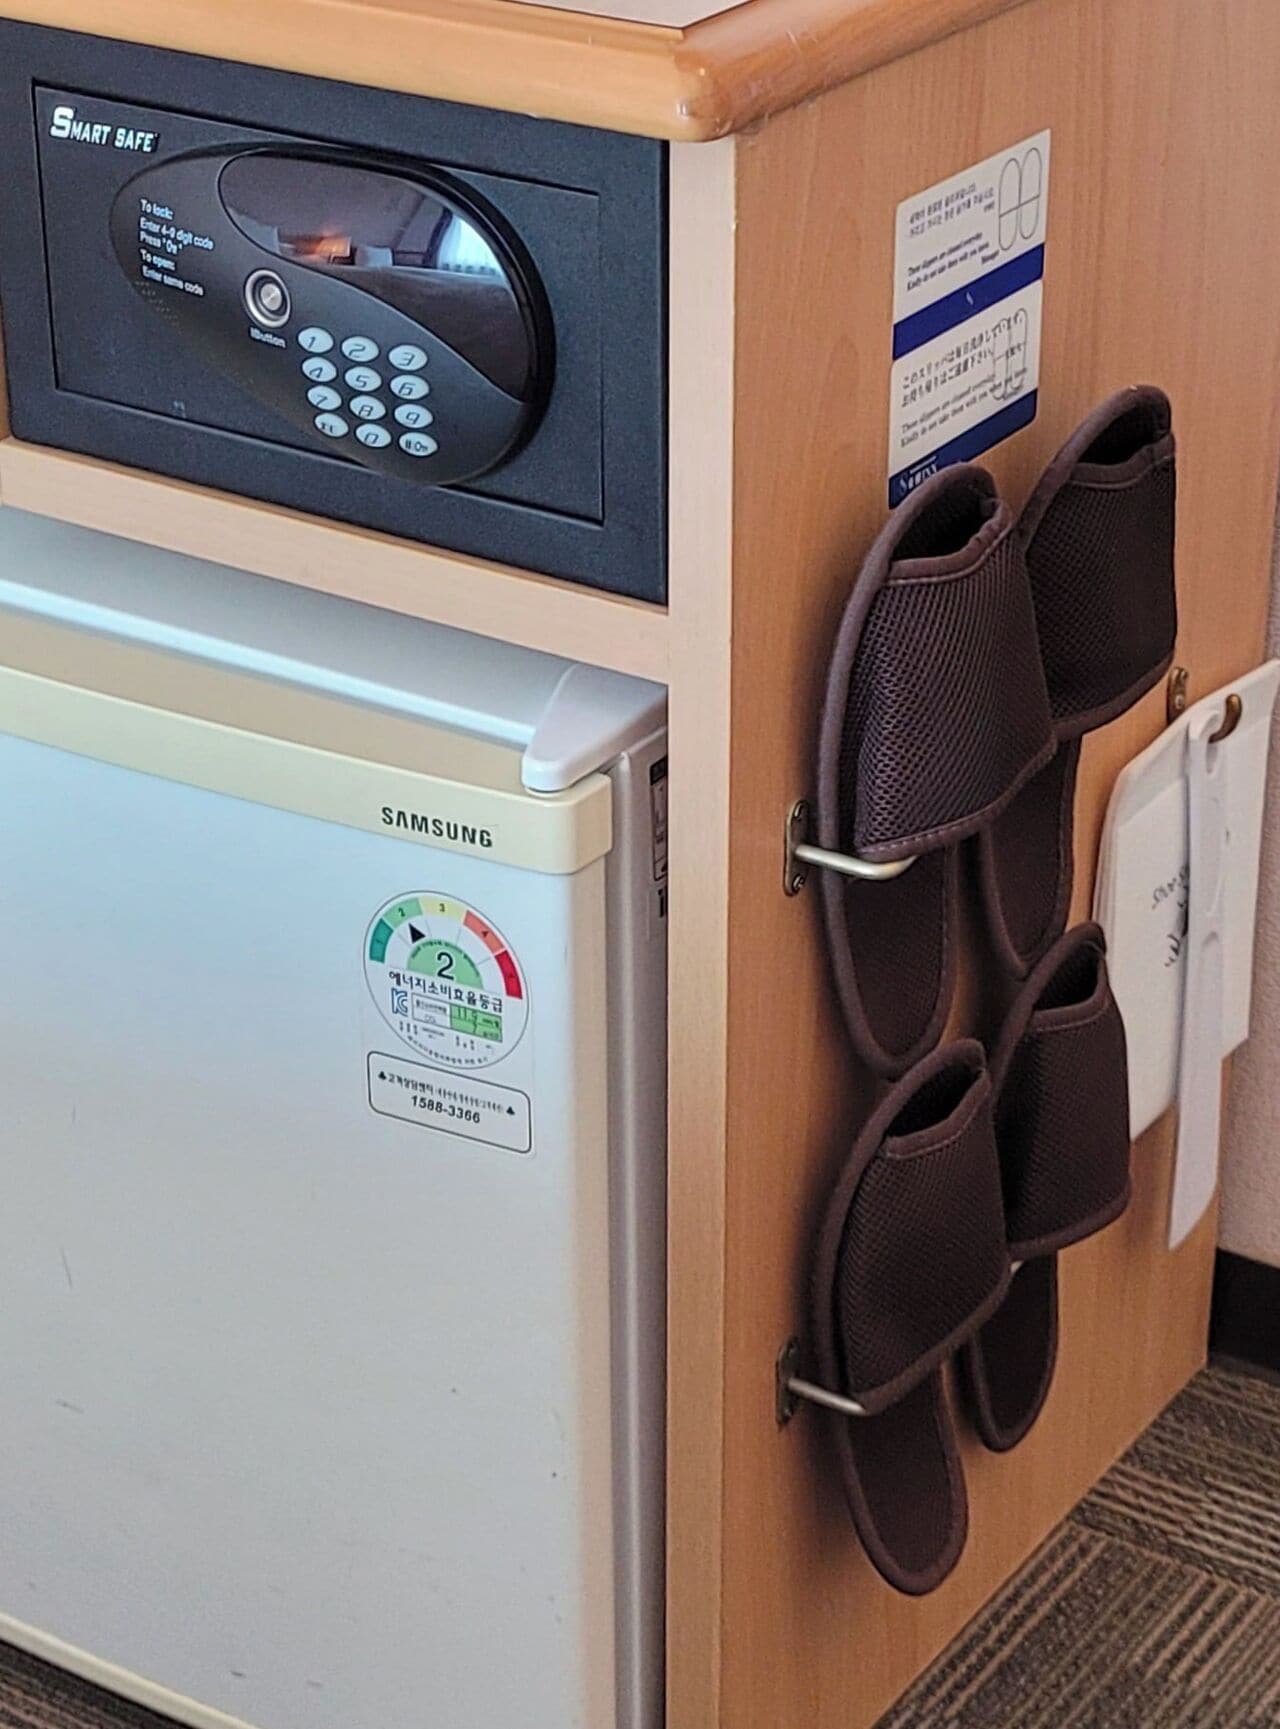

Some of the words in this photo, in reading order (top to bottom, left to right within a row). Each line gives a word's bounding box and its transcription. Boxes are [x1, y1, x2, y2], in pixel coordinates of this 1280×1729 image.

[50, 106, 111, 145] SMART
[114, 127, 155, 153] SAFE
[140, 199, 152, 214] To
[140, 249, 152, 263] To
[308, 336, 316, 349] 1
[348, 343, 367, 359] 2
[398, 352, 415, 367] 3
[354, 374, 370, 389] 5
[398, 381, 416, 397] 6
[315, 393, 328, 406] 7
[357, 404, 373, 418] 8
[405, 411, 421, 424] 9
[381, 806, 493, 848] SAMSUNG
[436, 951, 455, 981] 2
[389, 971, 503, 1014] 에너지소비효율등급
[411, 1094, 481, 1124] 1588-3366
